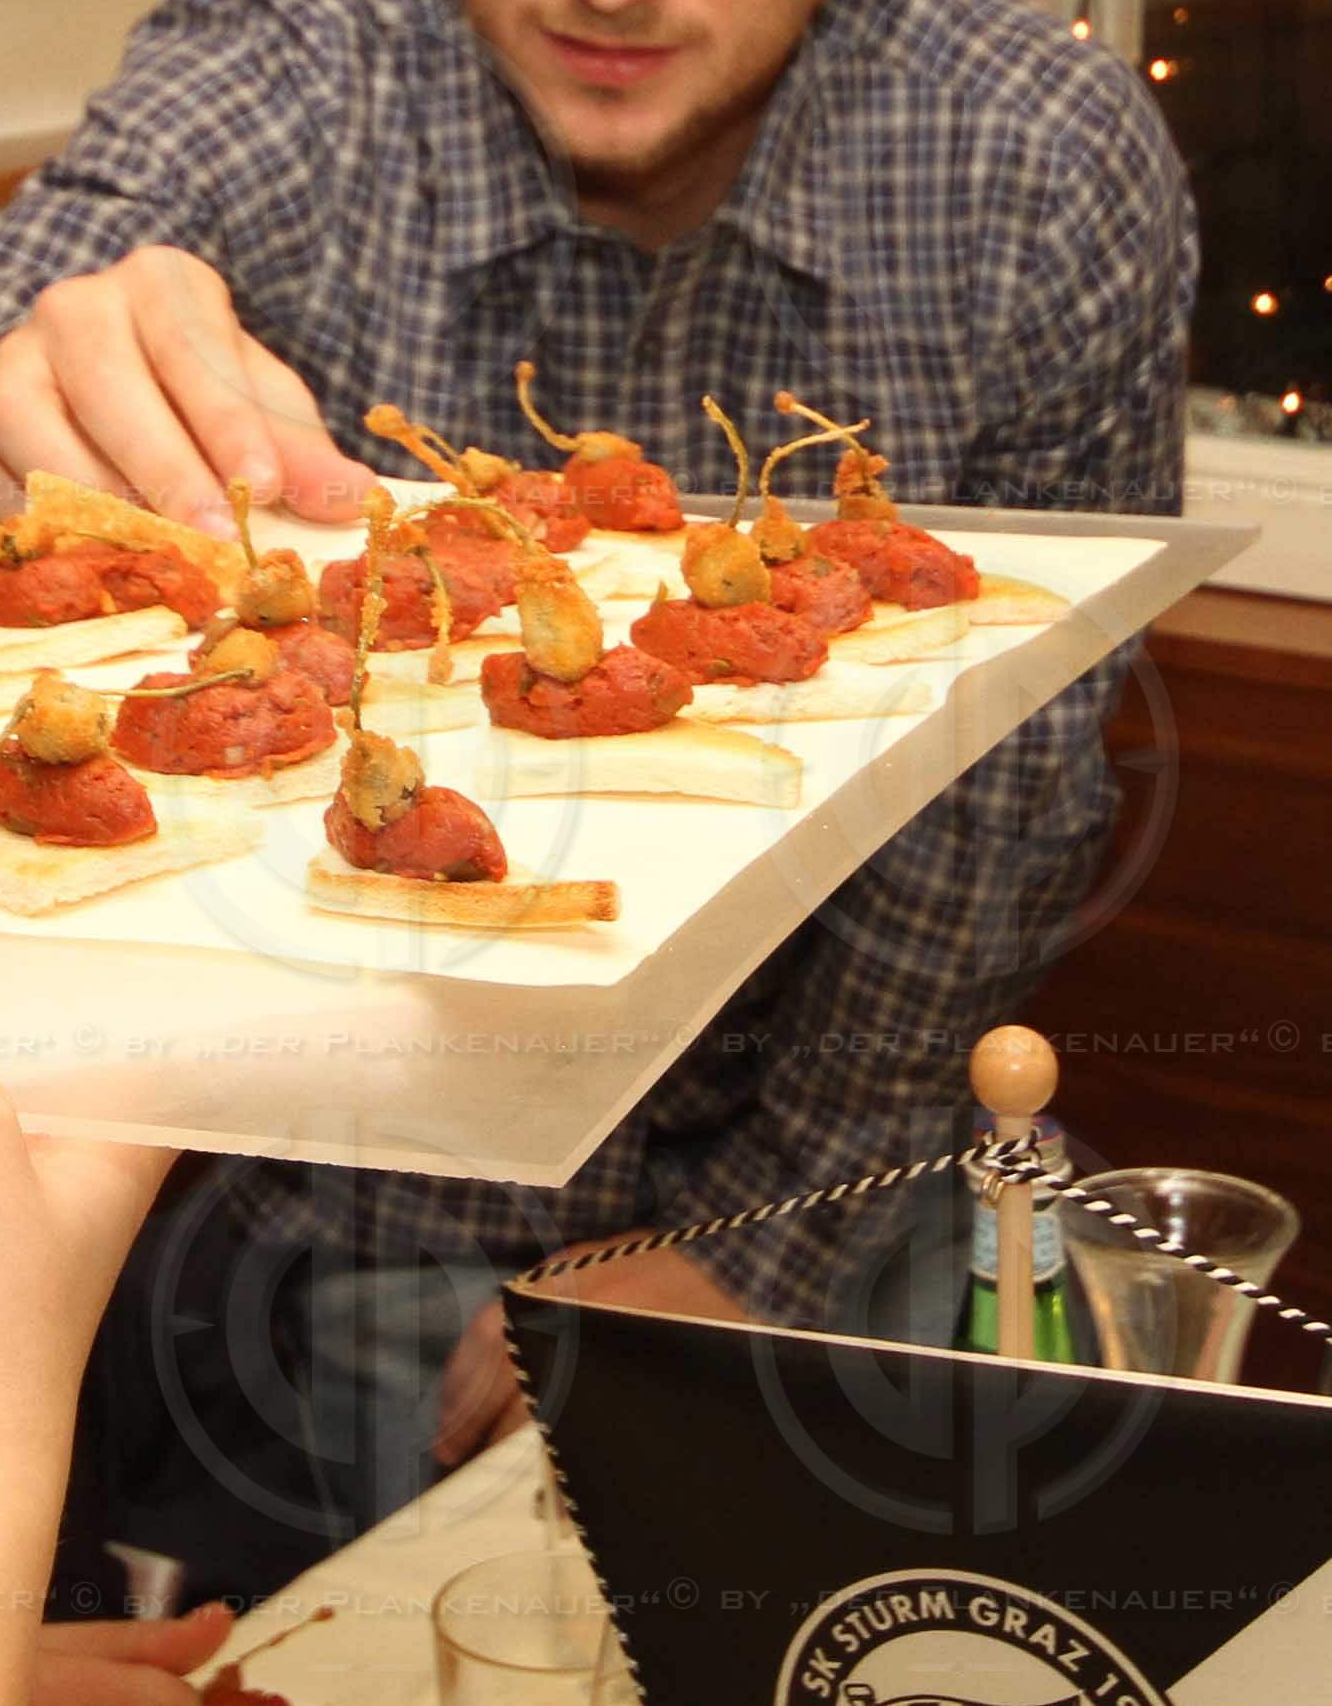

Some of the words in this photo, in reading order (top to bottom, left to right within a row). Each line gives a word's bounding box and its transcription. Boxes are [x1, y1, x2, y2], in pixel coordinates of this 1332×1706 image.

[802, 1647, 843, 1698] SK
[832, 1591, 955, 1653] STURM
[969, 1596, 1090, 1672] GRAZ
